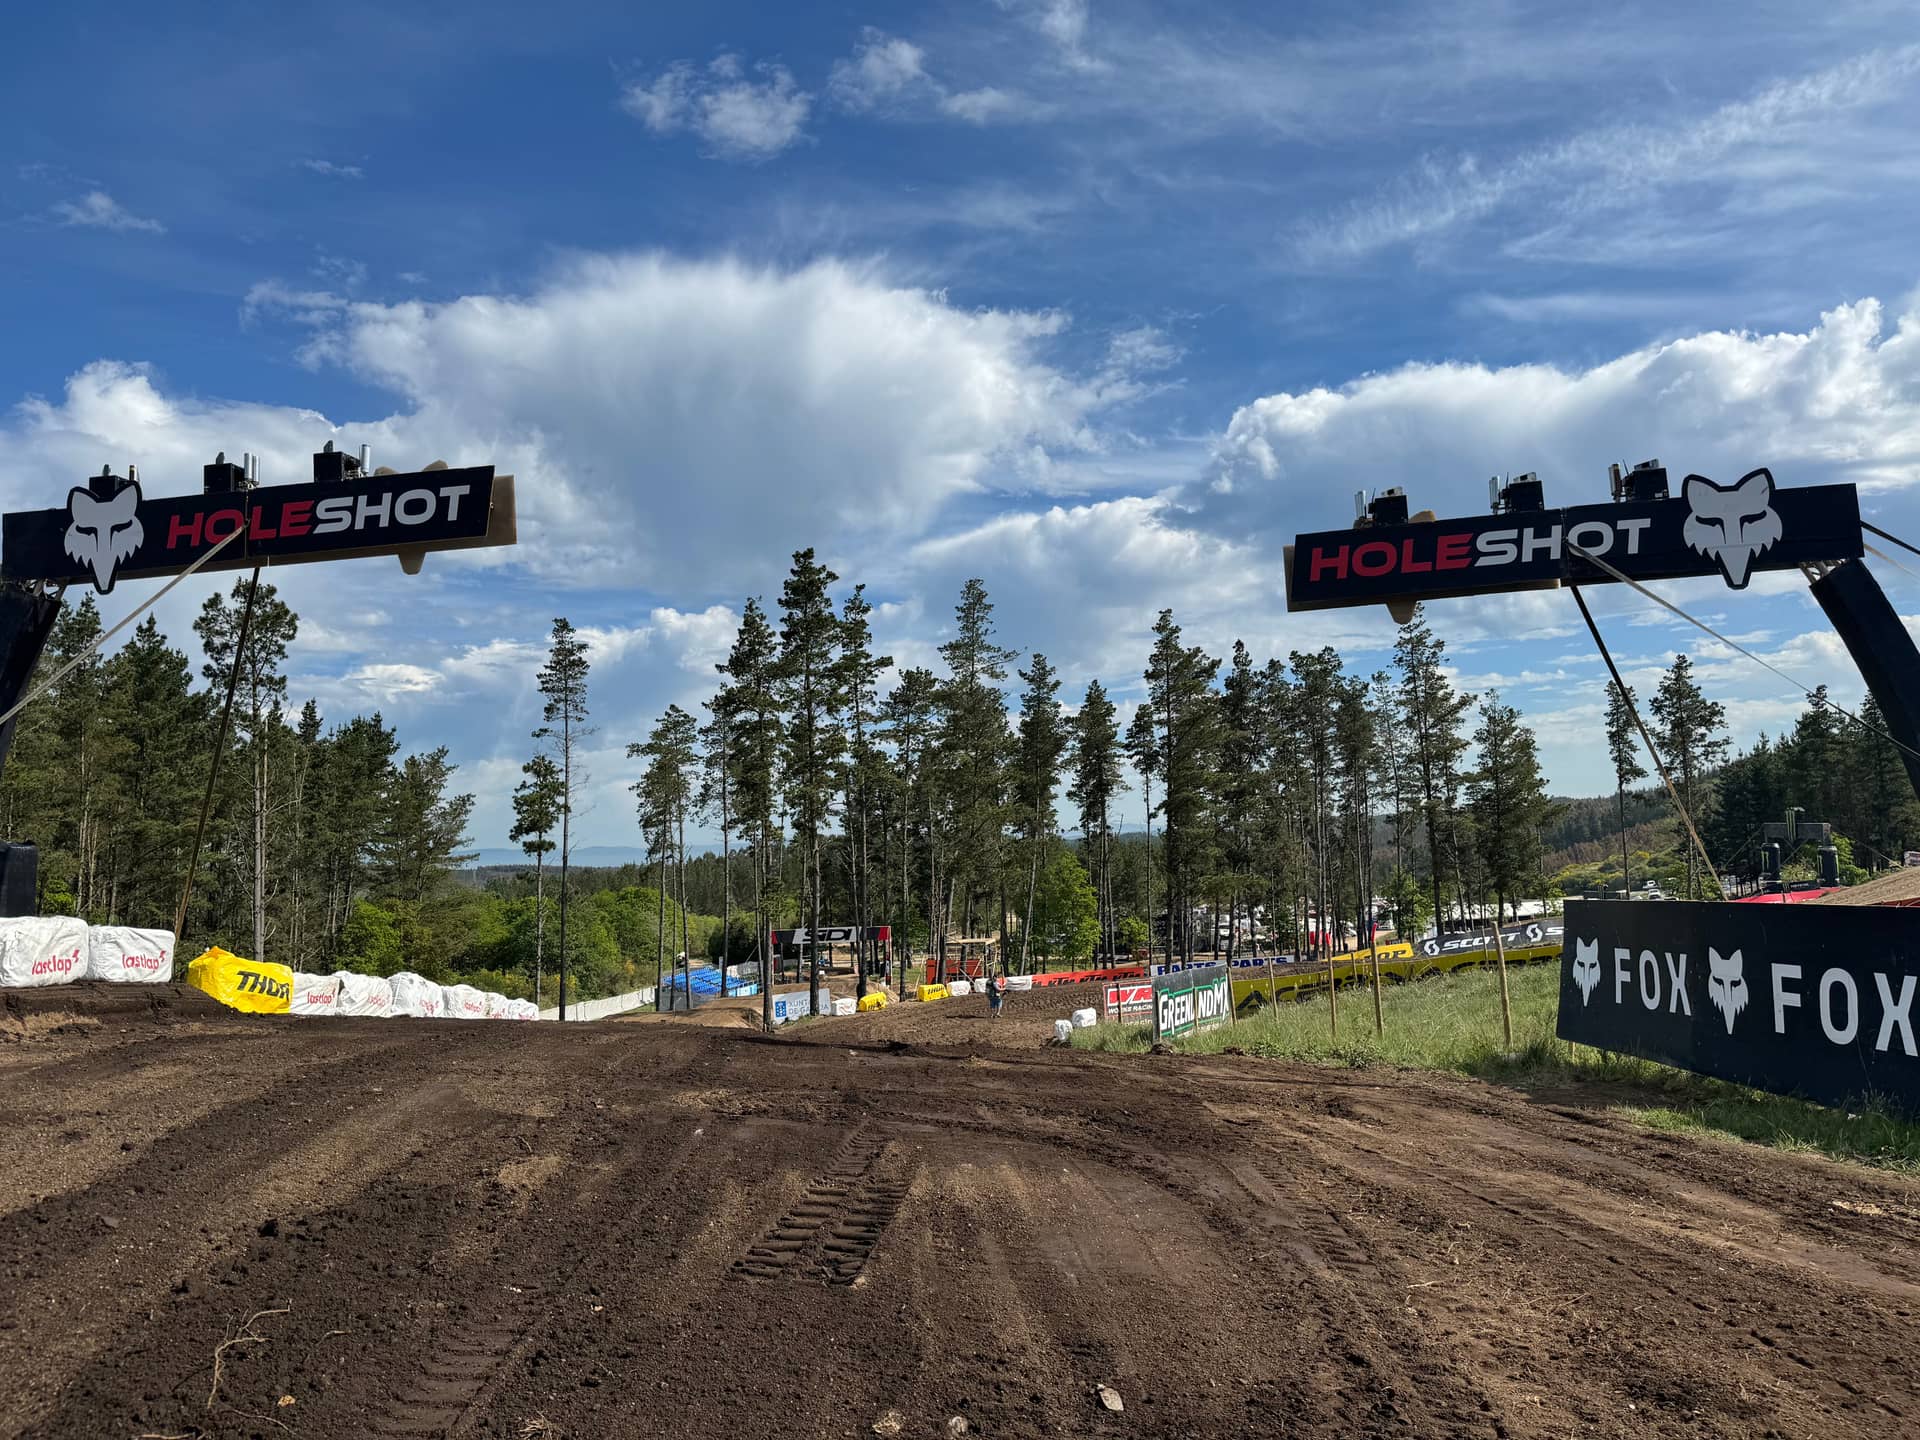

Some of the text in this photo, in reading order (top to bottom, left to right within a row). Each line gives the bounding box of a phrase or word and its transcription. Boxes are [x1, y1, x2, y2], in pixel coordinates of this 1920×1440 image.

[166, 485, 470, 549] HOLESHOT
[1309, 518, 1651, 582] HOLESHOT
[122, 953, 160, 970] lastlap
[236, 970, 290, 1002] THOR
[1614, 947, 1692, 1017] FOX
[1159, 981, 1229, 1035] GREENLNDMX
[1771, 962, 1918, 1057] FOX
